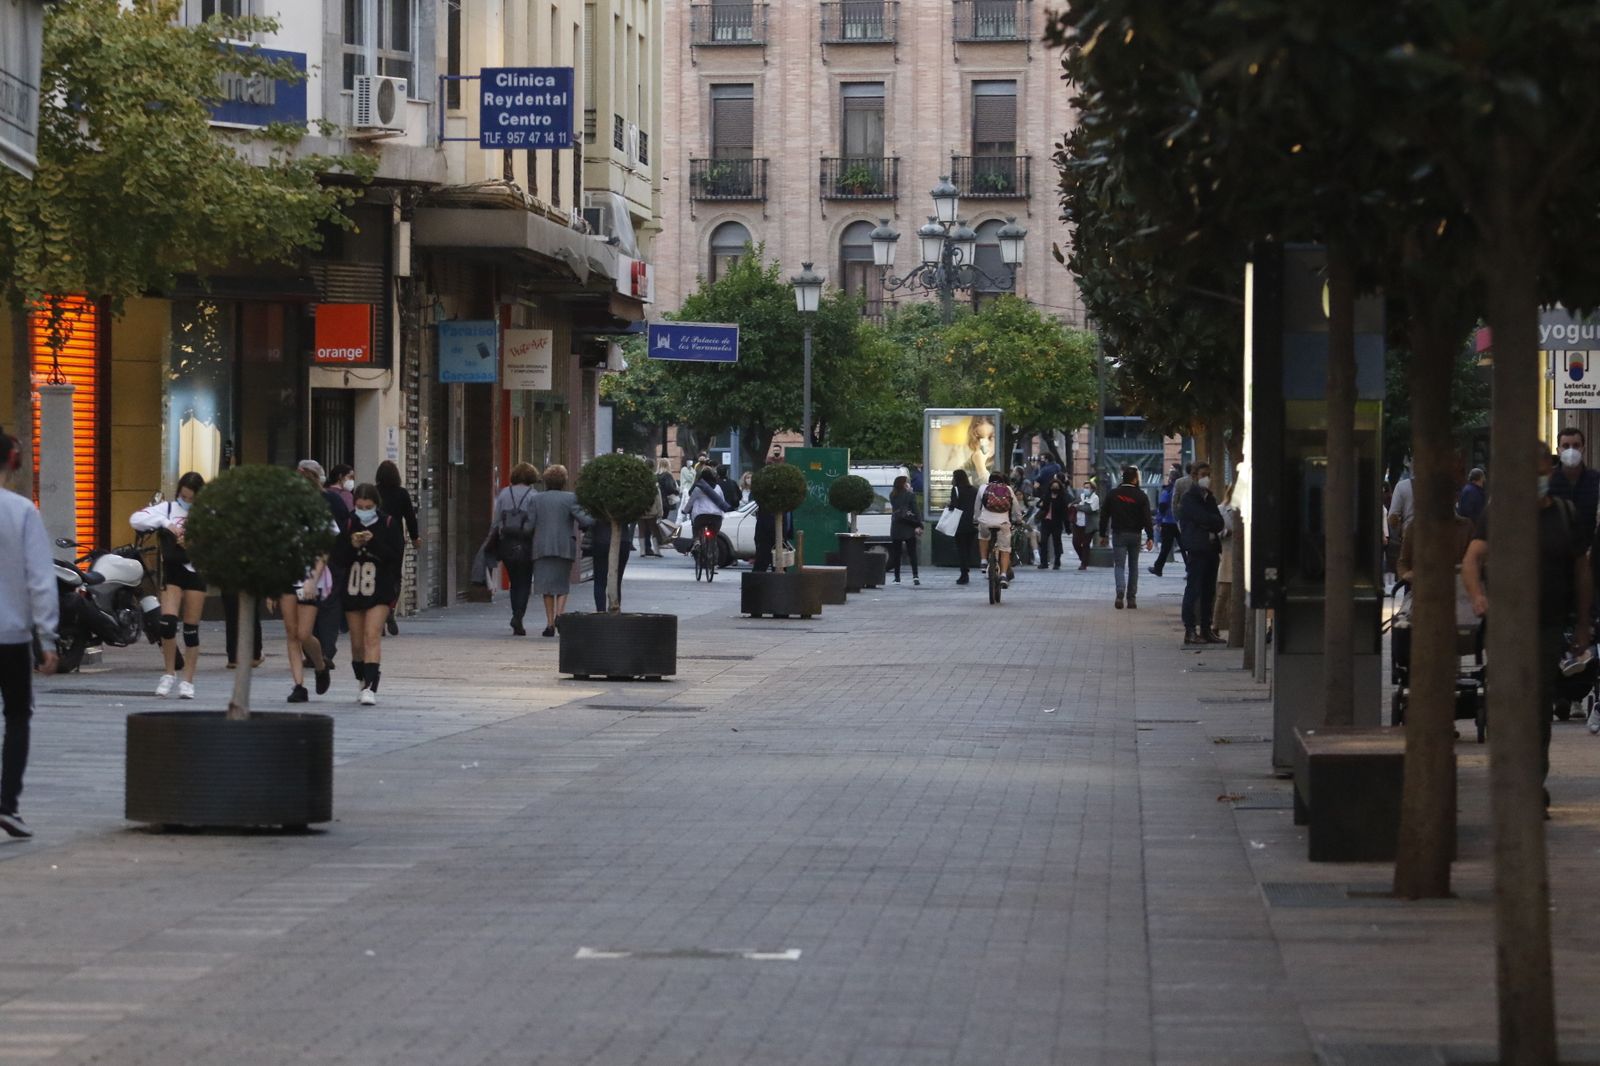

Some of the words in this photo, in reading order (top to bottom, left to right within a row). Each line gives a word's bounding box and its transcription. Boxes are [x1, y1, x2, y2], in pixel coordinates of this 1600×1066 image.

[496, 73, 555, 87] Clínica
[484, 92, 567, 108] Reydental
[498, 112, 552, 126] Centro
[484, 131, 503, 144] TLF.
[507, 131, 525, 144] 957
[529, 131, 540, 144] 47
[544, 131, 554, 144] 14
[558, 131, 567, 144] 11
[317, 348, 363, 360] orange
[347, 561, 376, 597] 08
